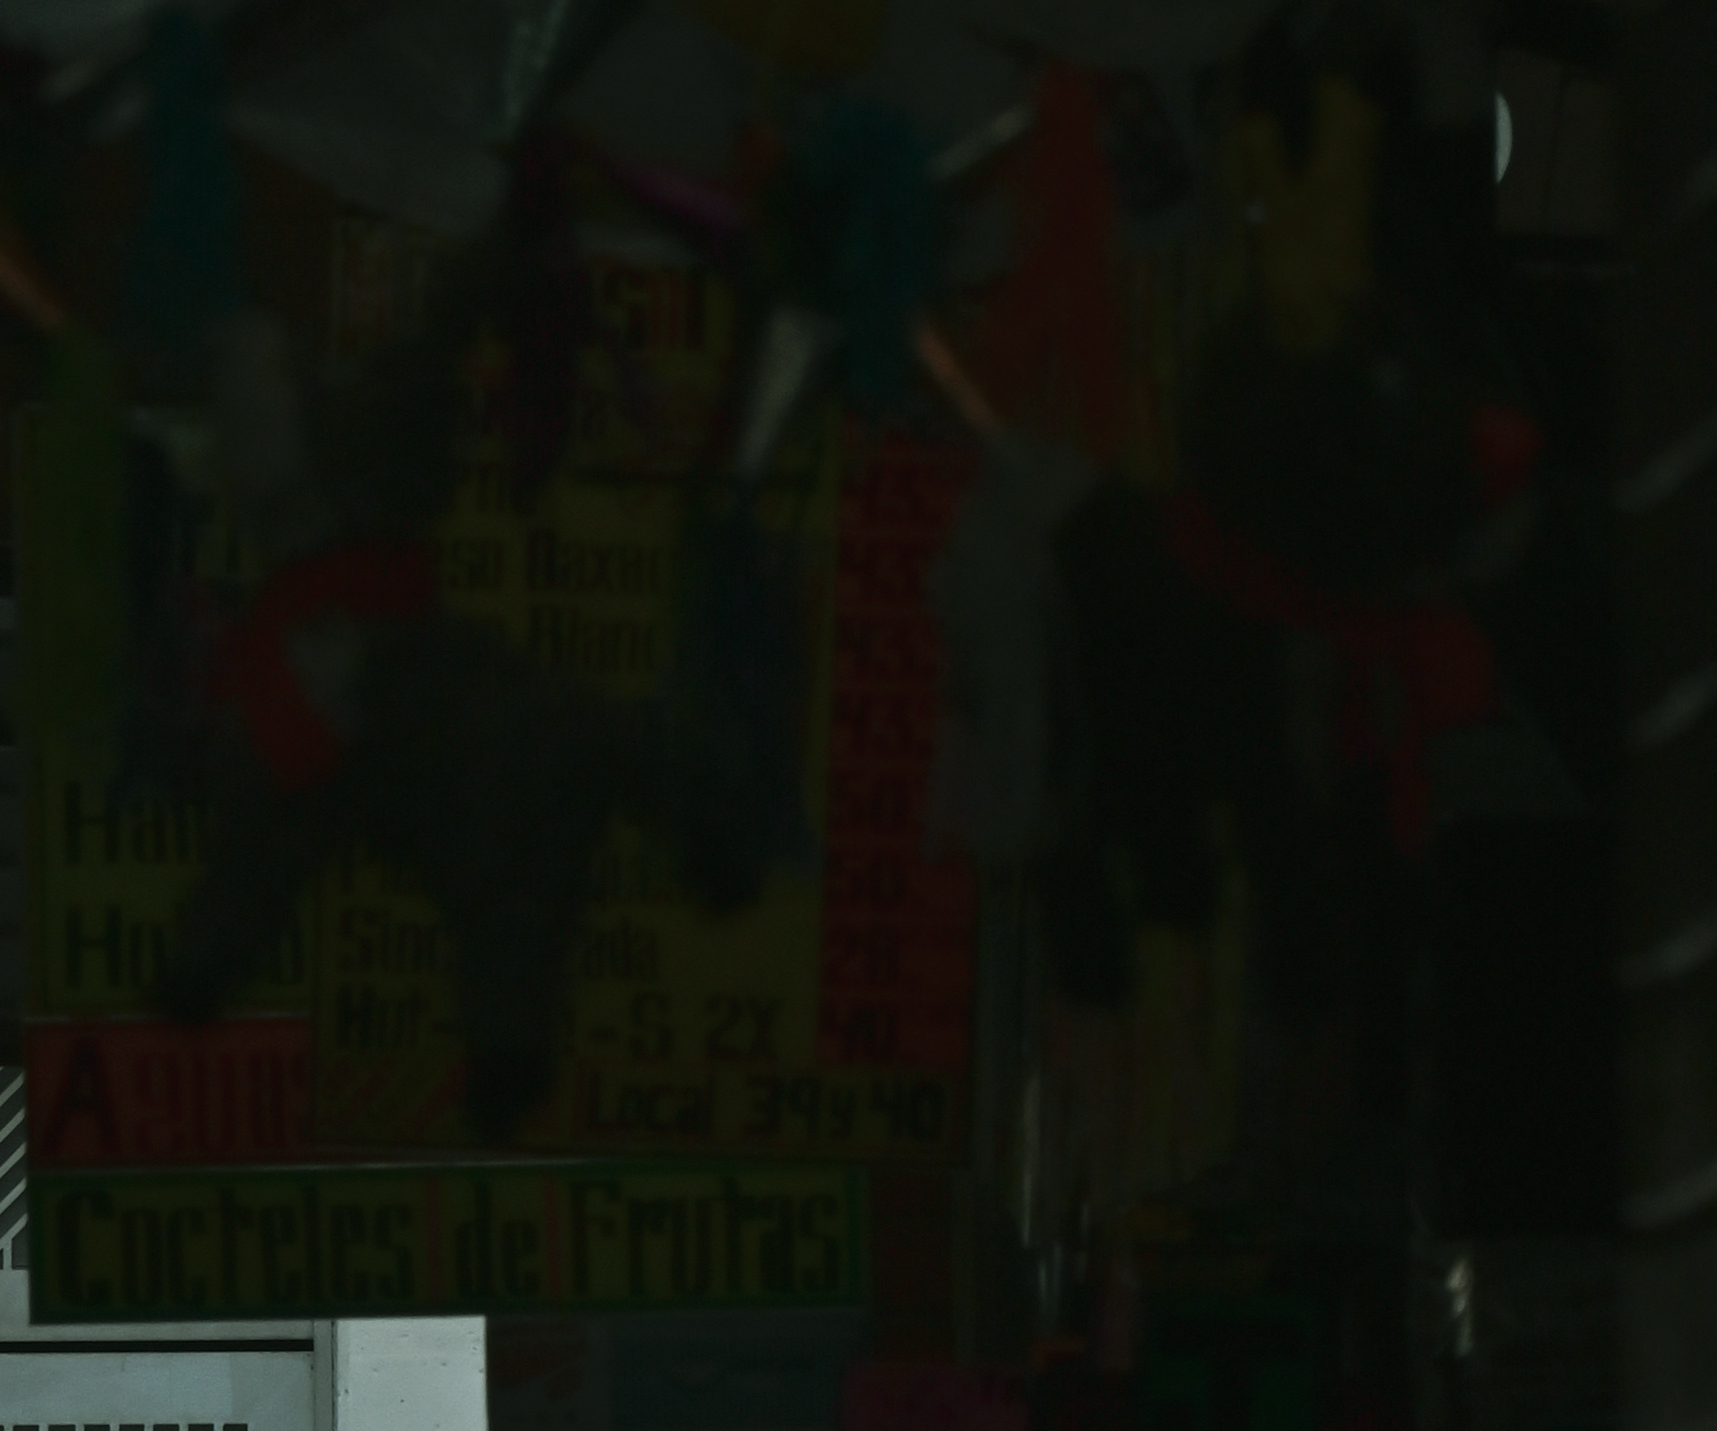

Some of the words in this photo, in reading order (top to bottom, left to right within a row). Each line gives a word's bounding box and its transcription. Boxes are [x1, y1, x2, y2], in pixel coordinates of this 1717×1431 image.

[585, 1070, 717, 1138] Local
[56, 1175, 413, 1310] Cocteles
[454, 1176, 539, 1299] de
[567, 1177, 843, 1299] Frutas
